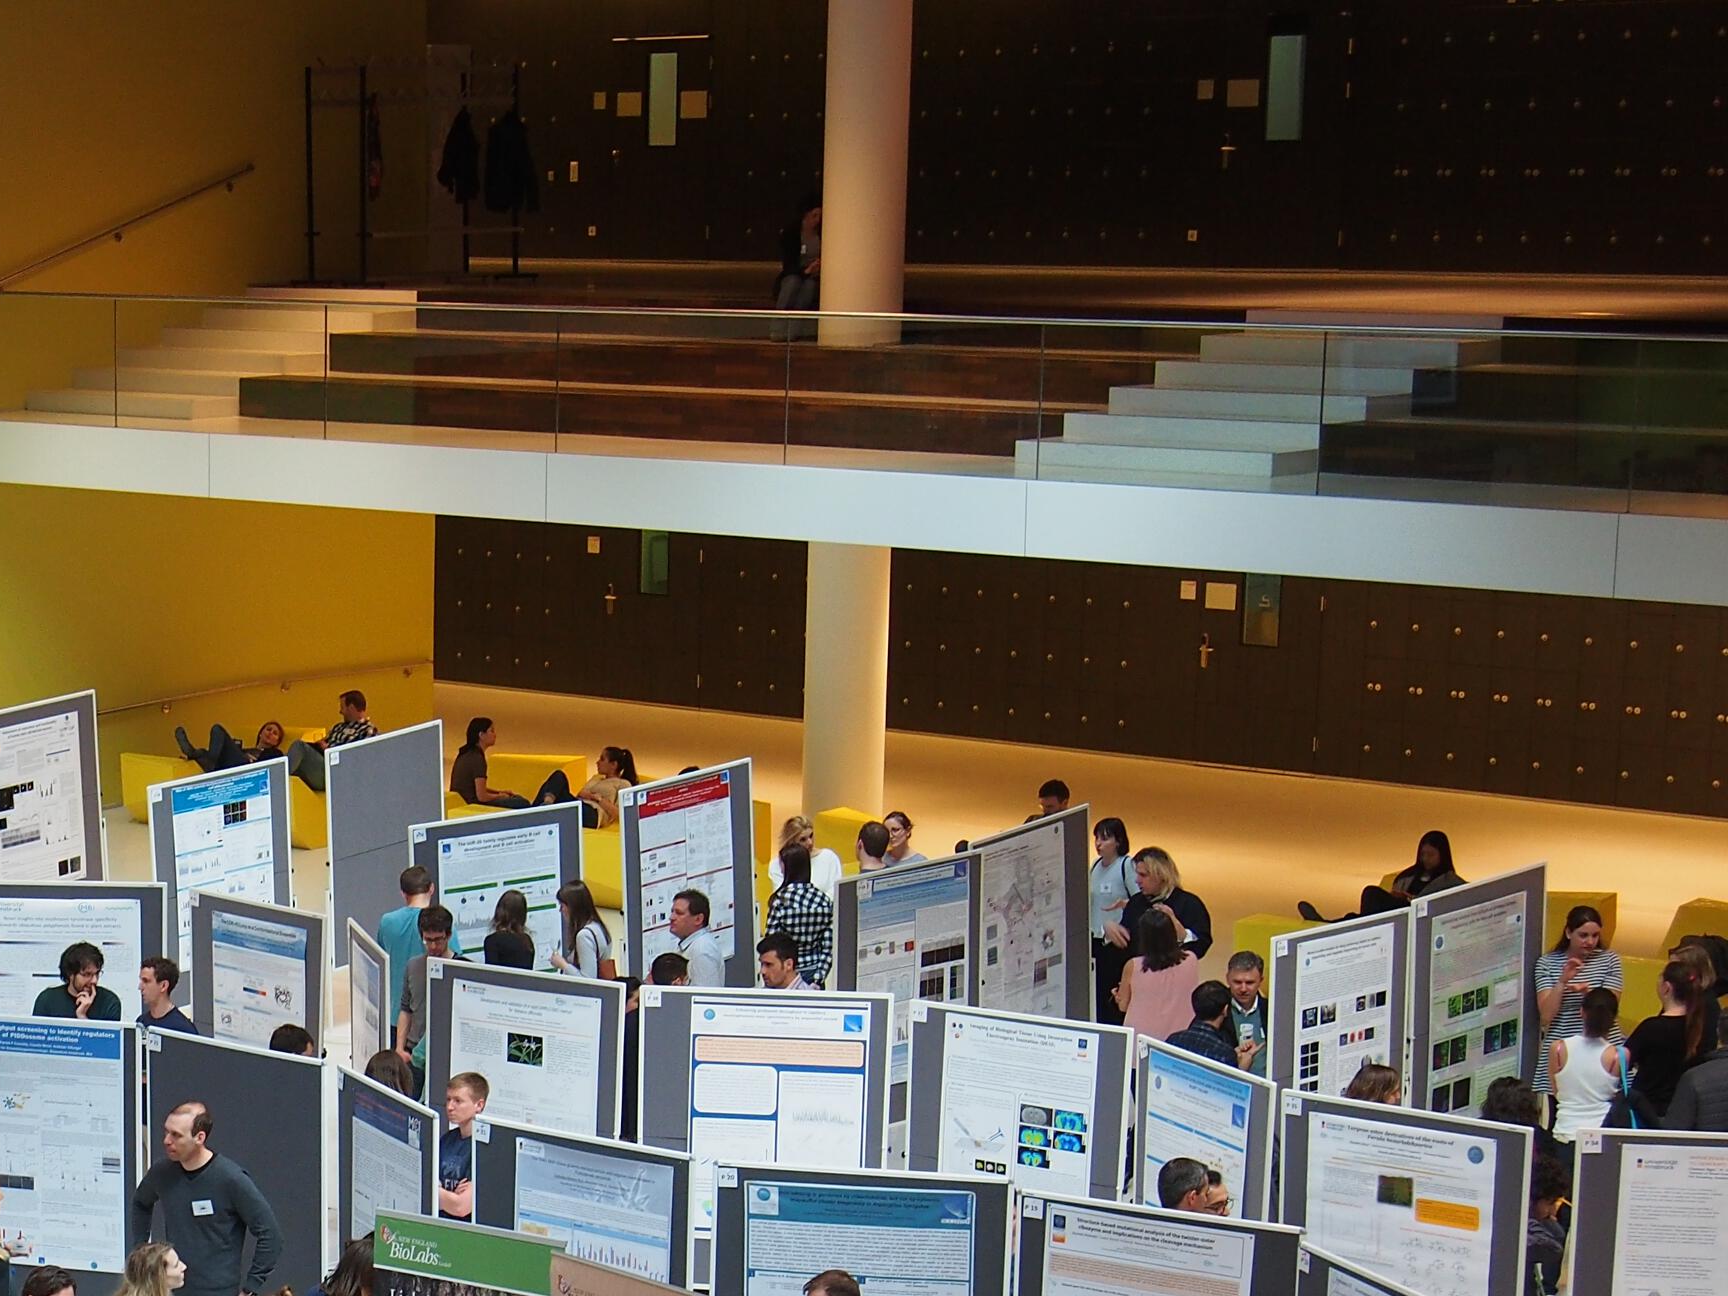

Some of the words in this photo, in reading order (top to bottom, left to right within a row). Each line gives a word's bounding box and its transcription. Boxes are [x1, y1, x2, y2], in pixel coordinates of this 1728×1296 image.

[17, 1026, 48, 1035] screening
[57, 1028, 81, 1037] identify
[1117, 1223, 1143, 1233] mutational
[1144, 1228, 1165, 1238] analysis
[414, 1239, 437, 1251] ENGLAND
[1102, 1228, 1111, 1236] and
[1112, 1228, 1143, 1240] implications
[1160, 1237, 1183, 1248] cleavage
[1183, 1241, 1214, 1250] mechanism
[389, 1242, 440, 1266] BioLabs
